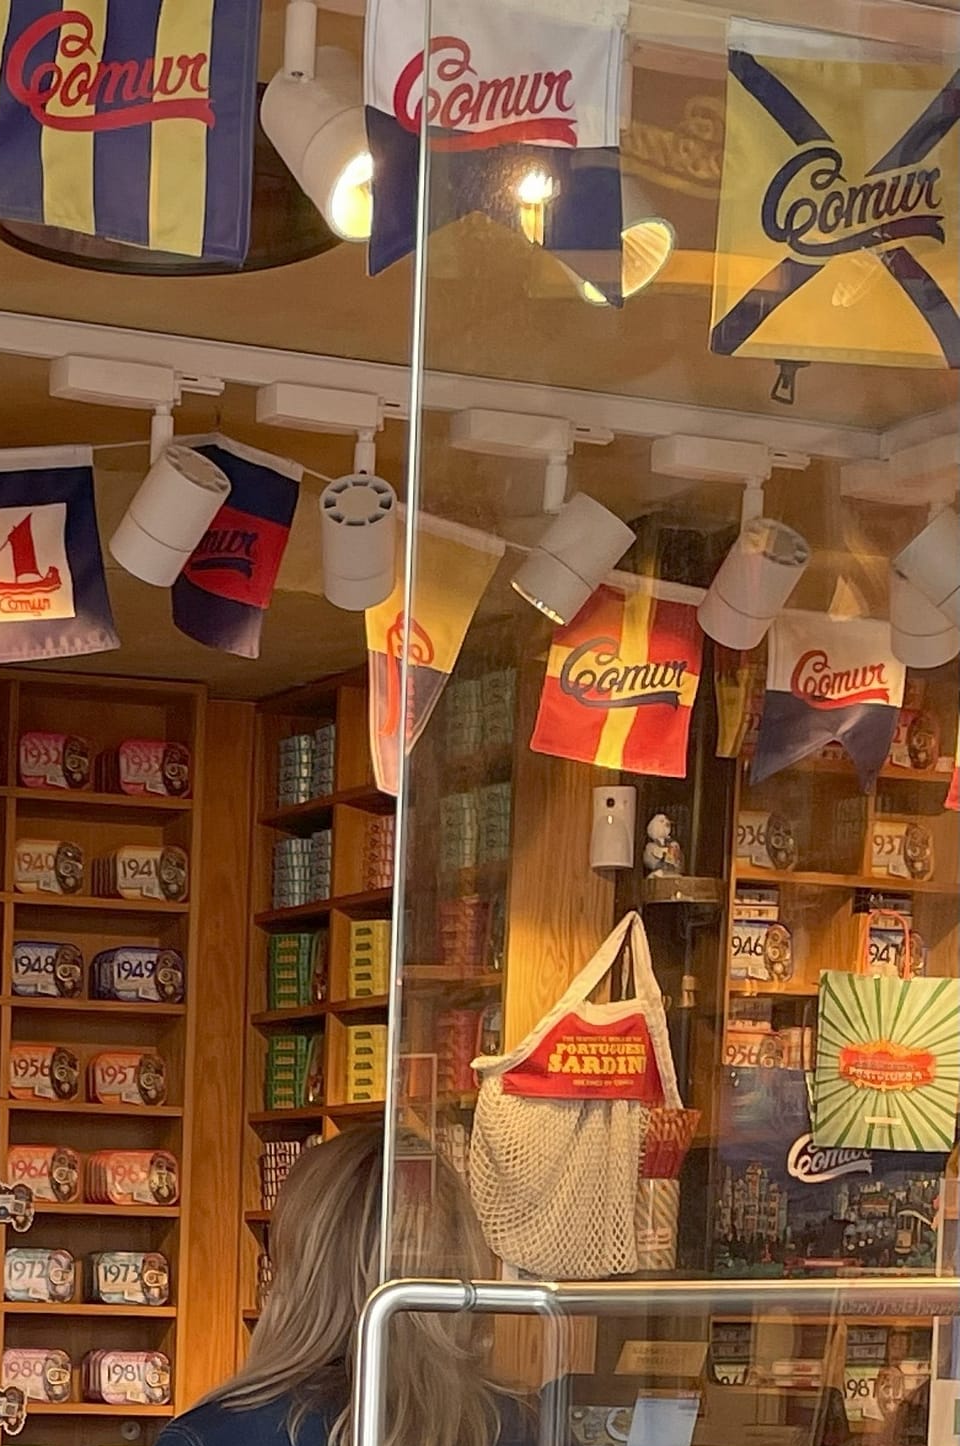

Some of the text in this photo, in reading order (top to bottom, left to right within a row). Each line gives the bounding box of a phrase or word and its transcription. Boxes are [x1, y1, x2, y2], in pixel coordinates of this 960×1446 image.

[6, 10, 215, 132] Comur
[394, 36, 579, 152] Comur
[761, 147, 945, 257] Comur
[560, 636, 686, 710] Comur
[790, 649, 888, 711] Comur
[737, 825, 766, 845] 936
[873, 835, 903, 855] 937
[121, 858, 160, 879] 1941
[732, 936, 763, 957] 946
[869, 944, 898, 963] 947
[14, 953, 55, 974] 1948
[116, 960, 155, 979] 1949
[727, 1046, 758, 1062] 956
[13, 1057, 51, 1077] 1956
[11, 1159, 51, 1180] 1964
[103, 1263, 142, 1284] 1973
